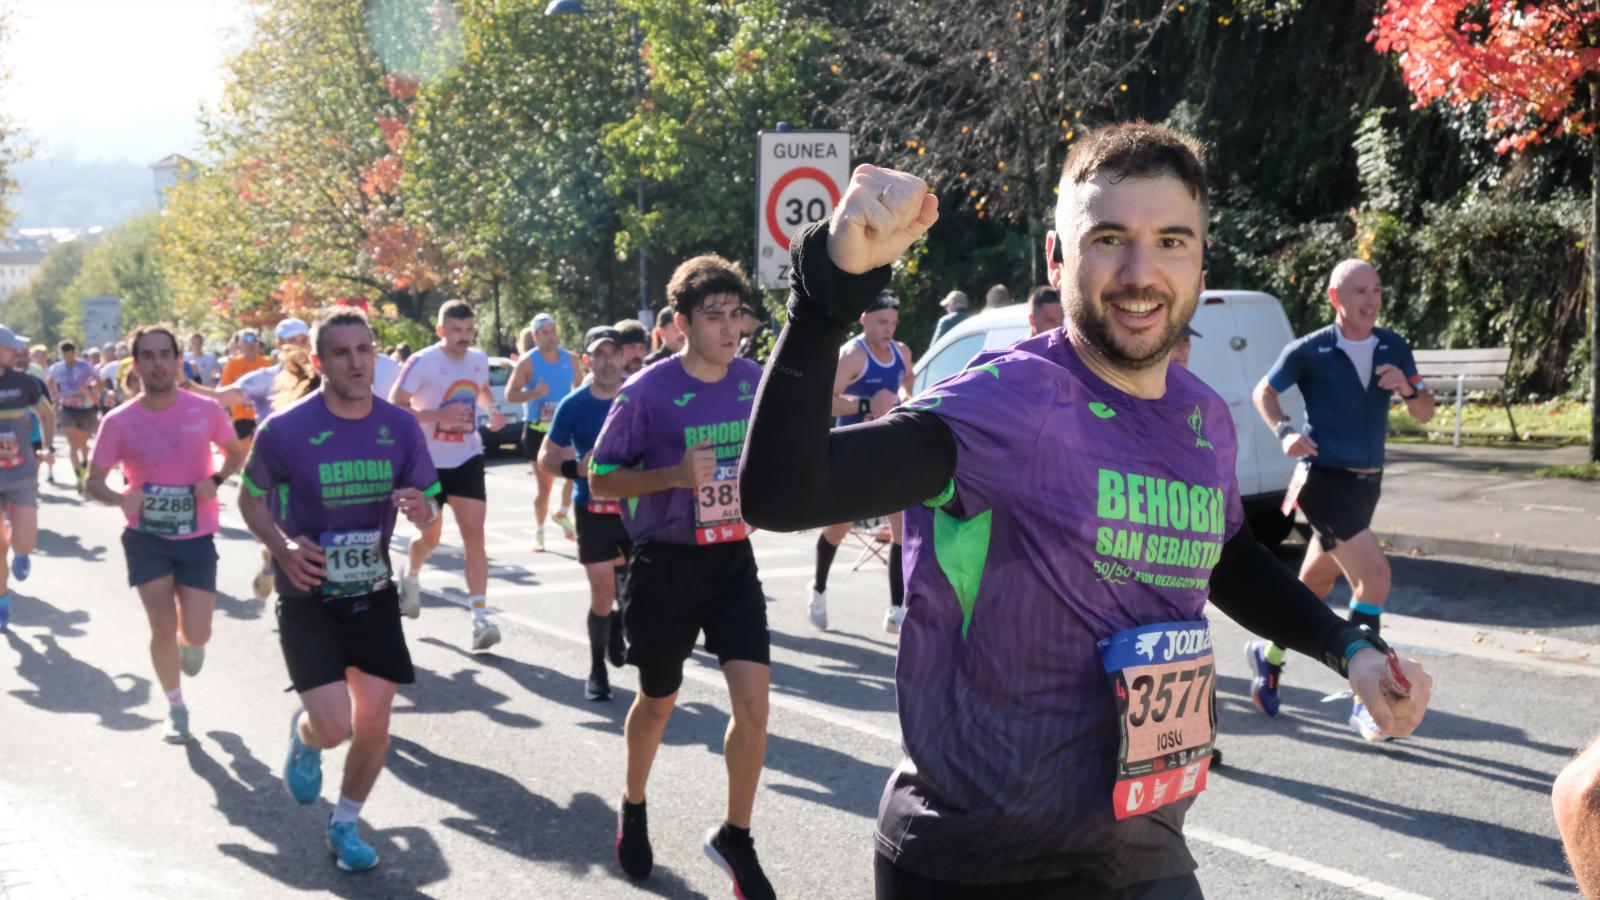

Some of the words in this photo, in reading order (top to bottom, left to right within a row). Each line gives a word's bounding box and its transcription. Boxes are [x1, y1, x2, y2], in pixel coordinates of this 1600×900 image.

[773, 143, 838, 159] GUNEA
[785, 198, 826, 226] 30
[684, 419, 750, 449] BEHOBI
[319, 459, 393, 484] BEHOBIA
[144, 497, 193, 513] 2288
[1097, 468, 1226, 535] BEHOBIA
[1095, 526, 1143, 561] SAN
[1093, 560, 1133, 581] 50/50
[1129, 662, 1214, 728] 3577
[1156, 730, 1183, 752] IOSU
